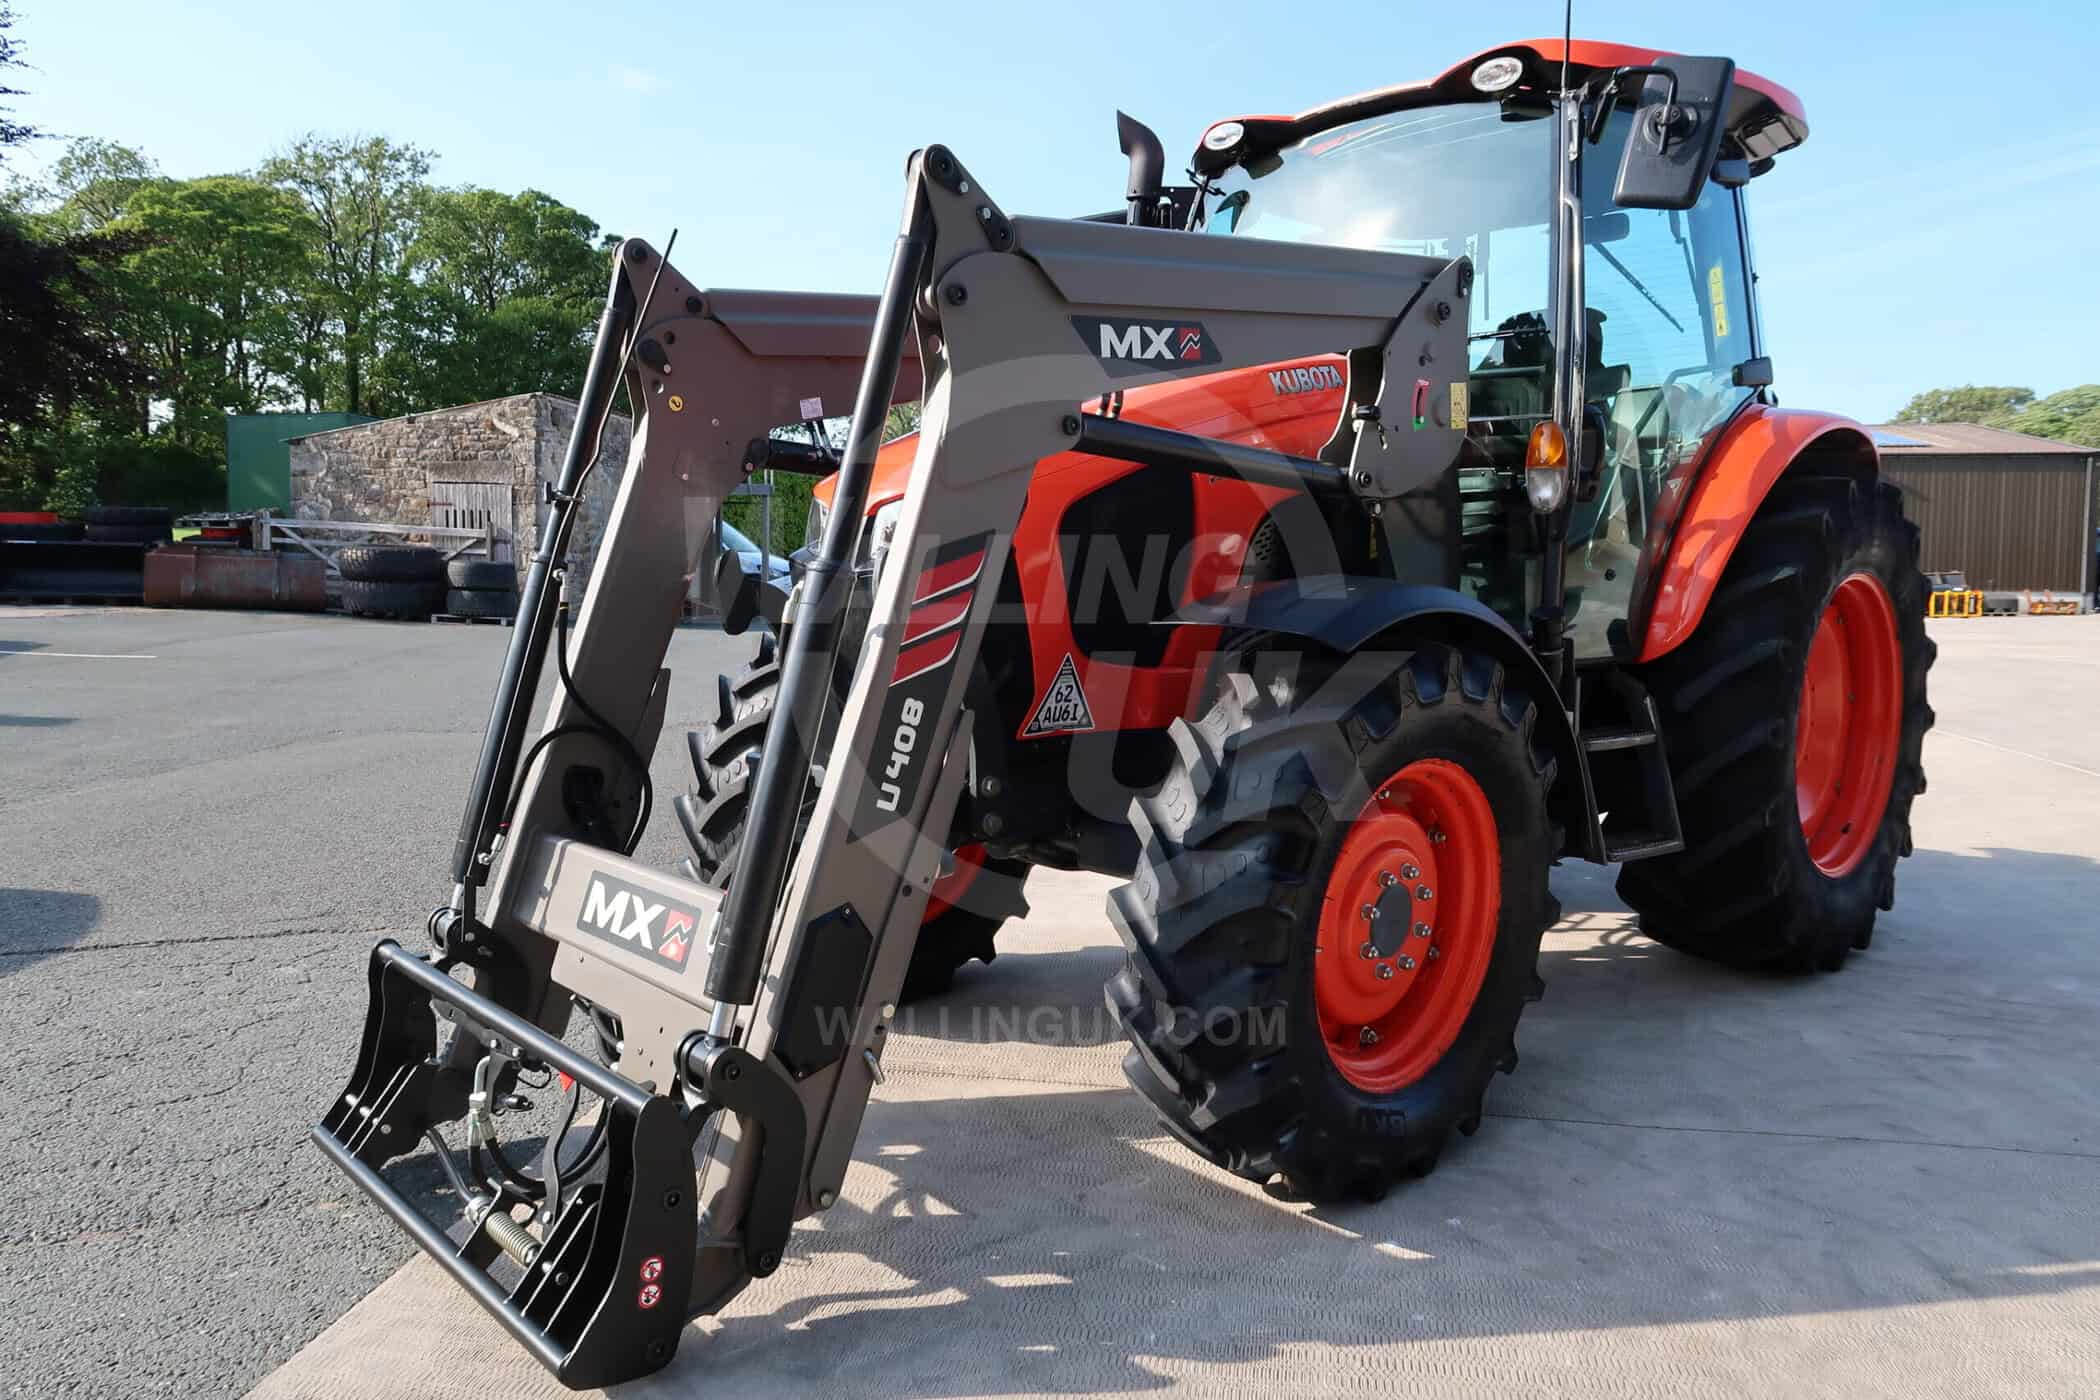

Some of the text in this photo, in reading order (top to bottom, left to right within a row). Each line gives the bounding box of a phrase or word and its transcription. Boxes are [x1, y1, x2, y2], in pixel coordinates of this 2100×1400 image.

[1100, 324, 1175, 359] MX
[1268, 365, 1344, 395] KUBOTA
[1055, 684, 1074, 704] 62
[582, 880, 666, 950] MX
